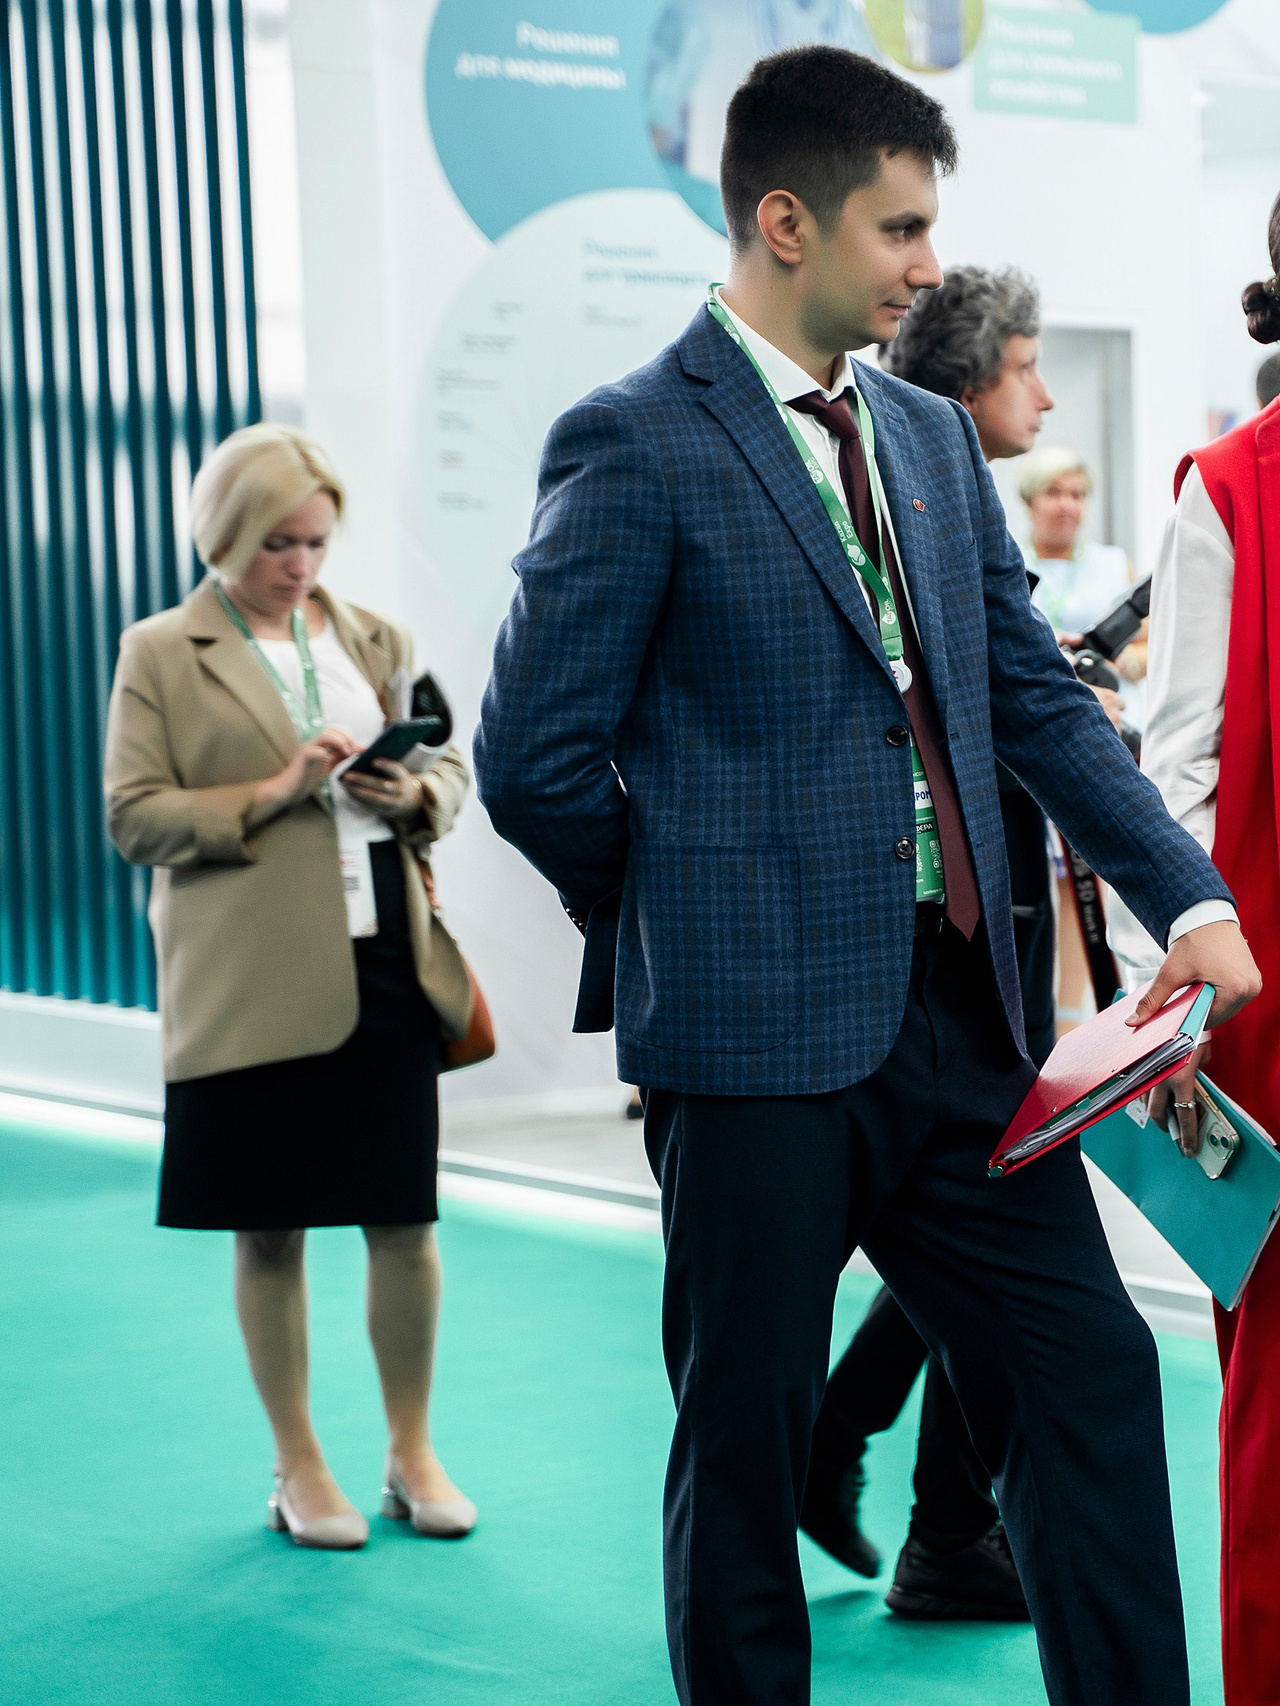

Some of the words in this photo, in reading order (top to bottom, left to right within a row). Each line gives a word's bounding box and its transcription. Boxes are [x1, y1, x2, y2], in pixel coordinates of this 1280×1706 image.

[515, 20, 619, 57] Решения
[454, 51, 500, 80] для
[834, 521, 846, 542] Kazan
[842, 520, 854, 539] Expo
